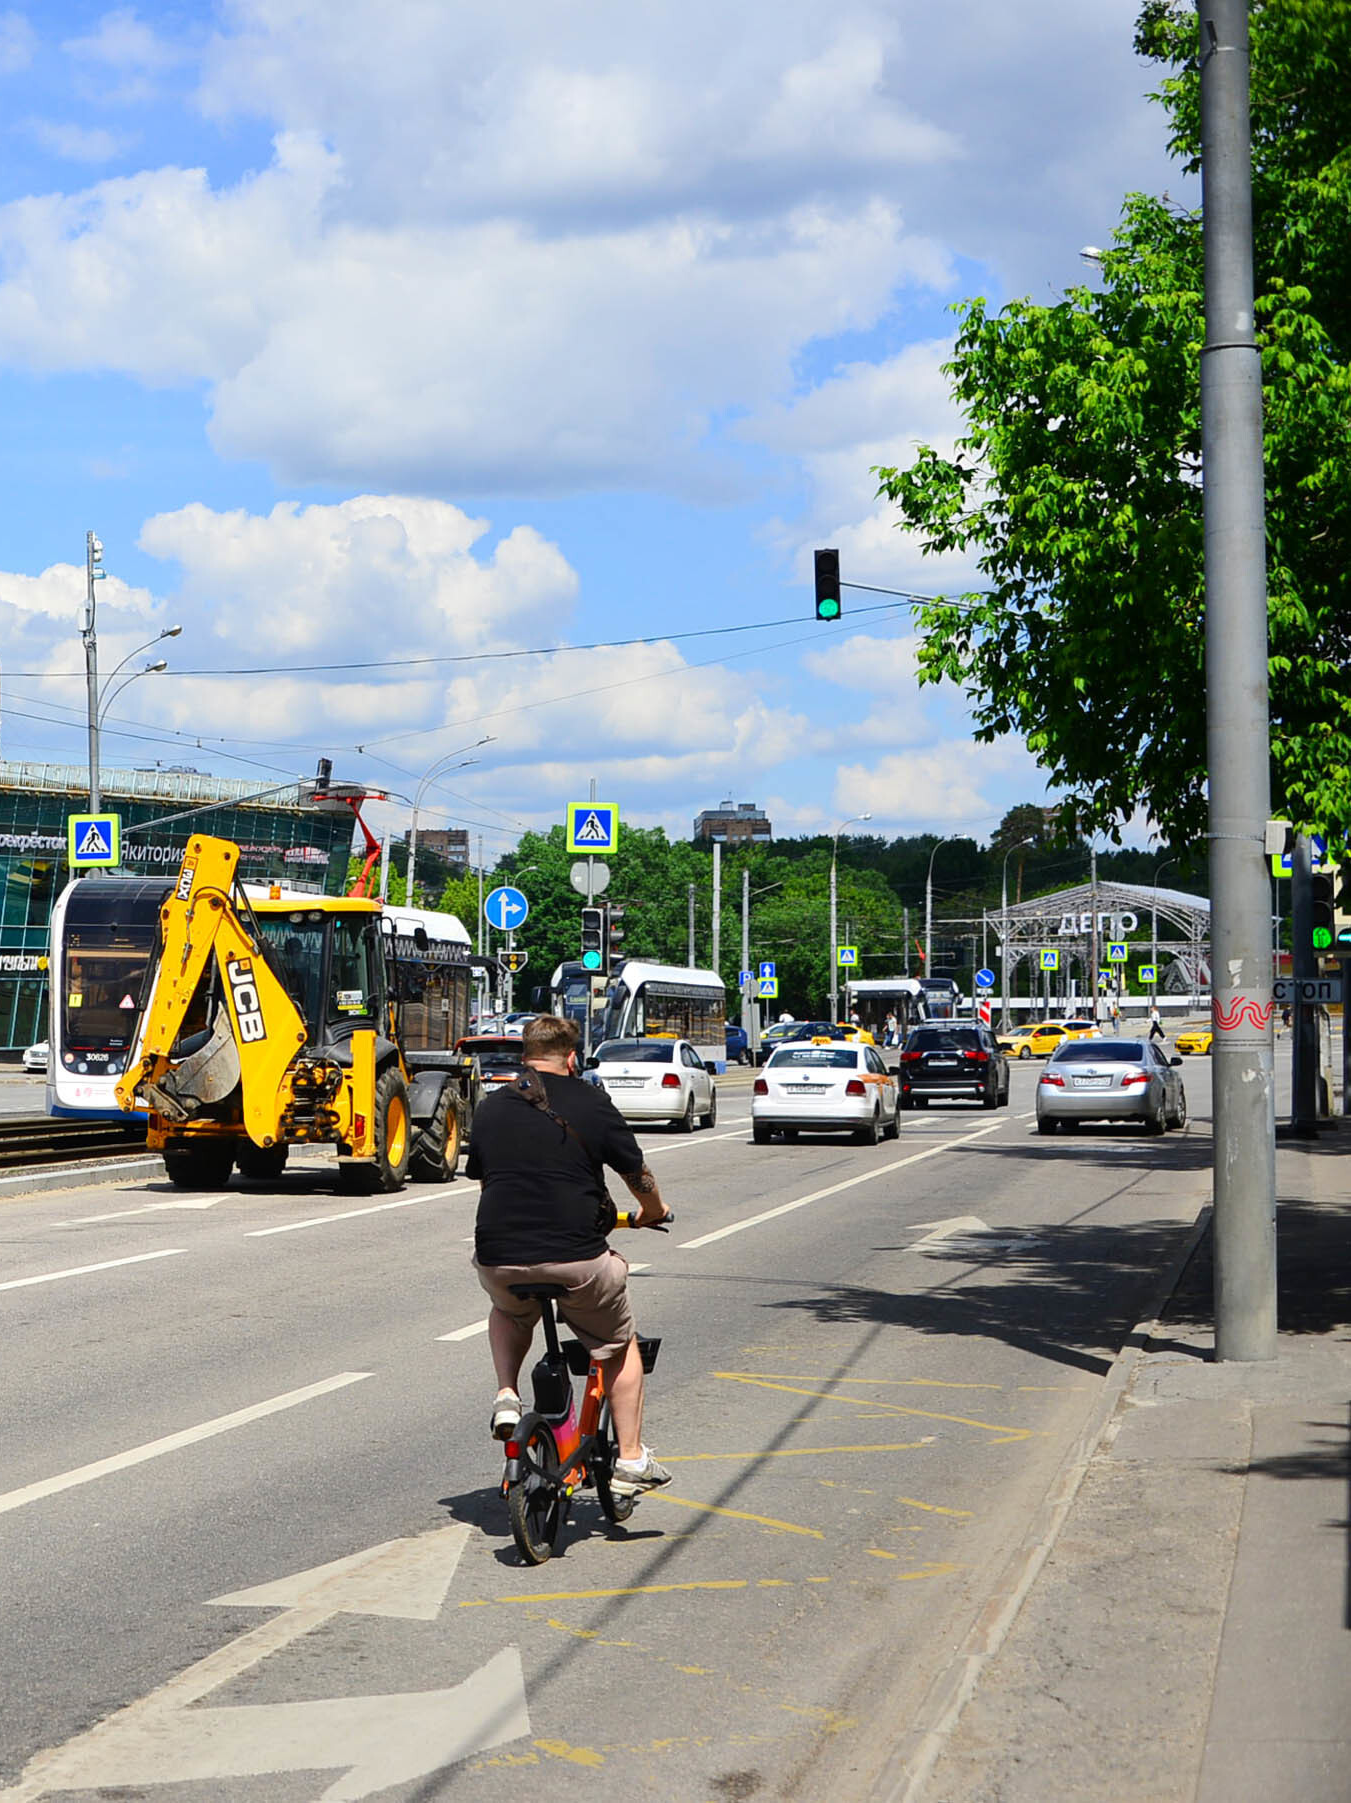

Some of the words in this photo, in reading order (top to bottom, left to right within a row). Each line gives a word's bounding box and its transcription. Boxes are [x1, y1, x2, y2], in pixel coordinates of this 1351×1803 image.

[1058, 912, 1138, 937] ДЕПО
[228, 960, 266, 1042] JCB
[1273, 982, 1331, 1000] СОП
